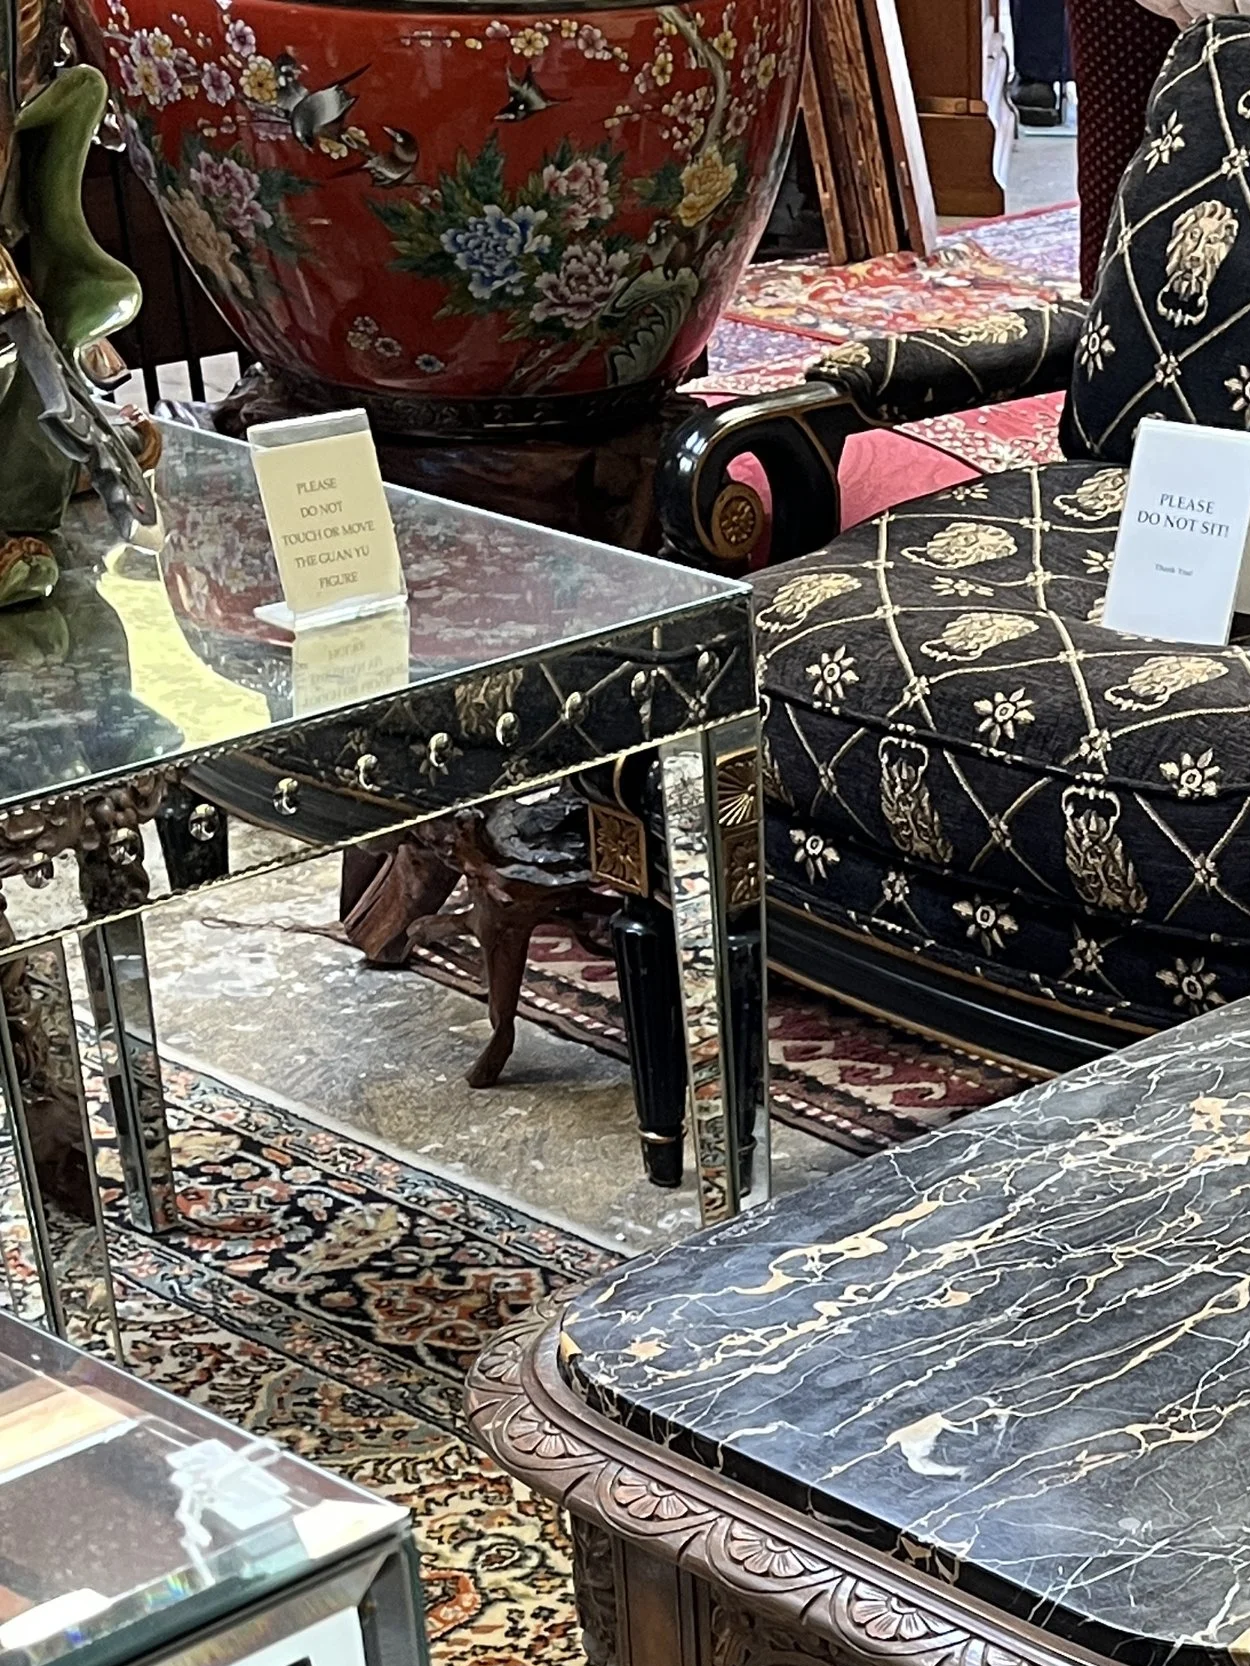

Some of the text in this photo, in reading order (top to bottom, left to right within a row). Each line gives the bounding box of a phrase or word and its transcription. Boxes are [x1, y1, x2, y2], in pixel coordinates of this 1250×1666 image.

[297, 478, 336, 495] PLEASE
[300, 501, 343, 519] DO NOT
[1160, 493, 1215, 514] PLEASE
[282, 520, 375, 547] TOUCH OR MOVE
[1137, 510, 1230, 538] DO NOT SIT!
[295, 545, 370, 569] THE GUAN YU
[319, 572, 358, 589] FIGURE
